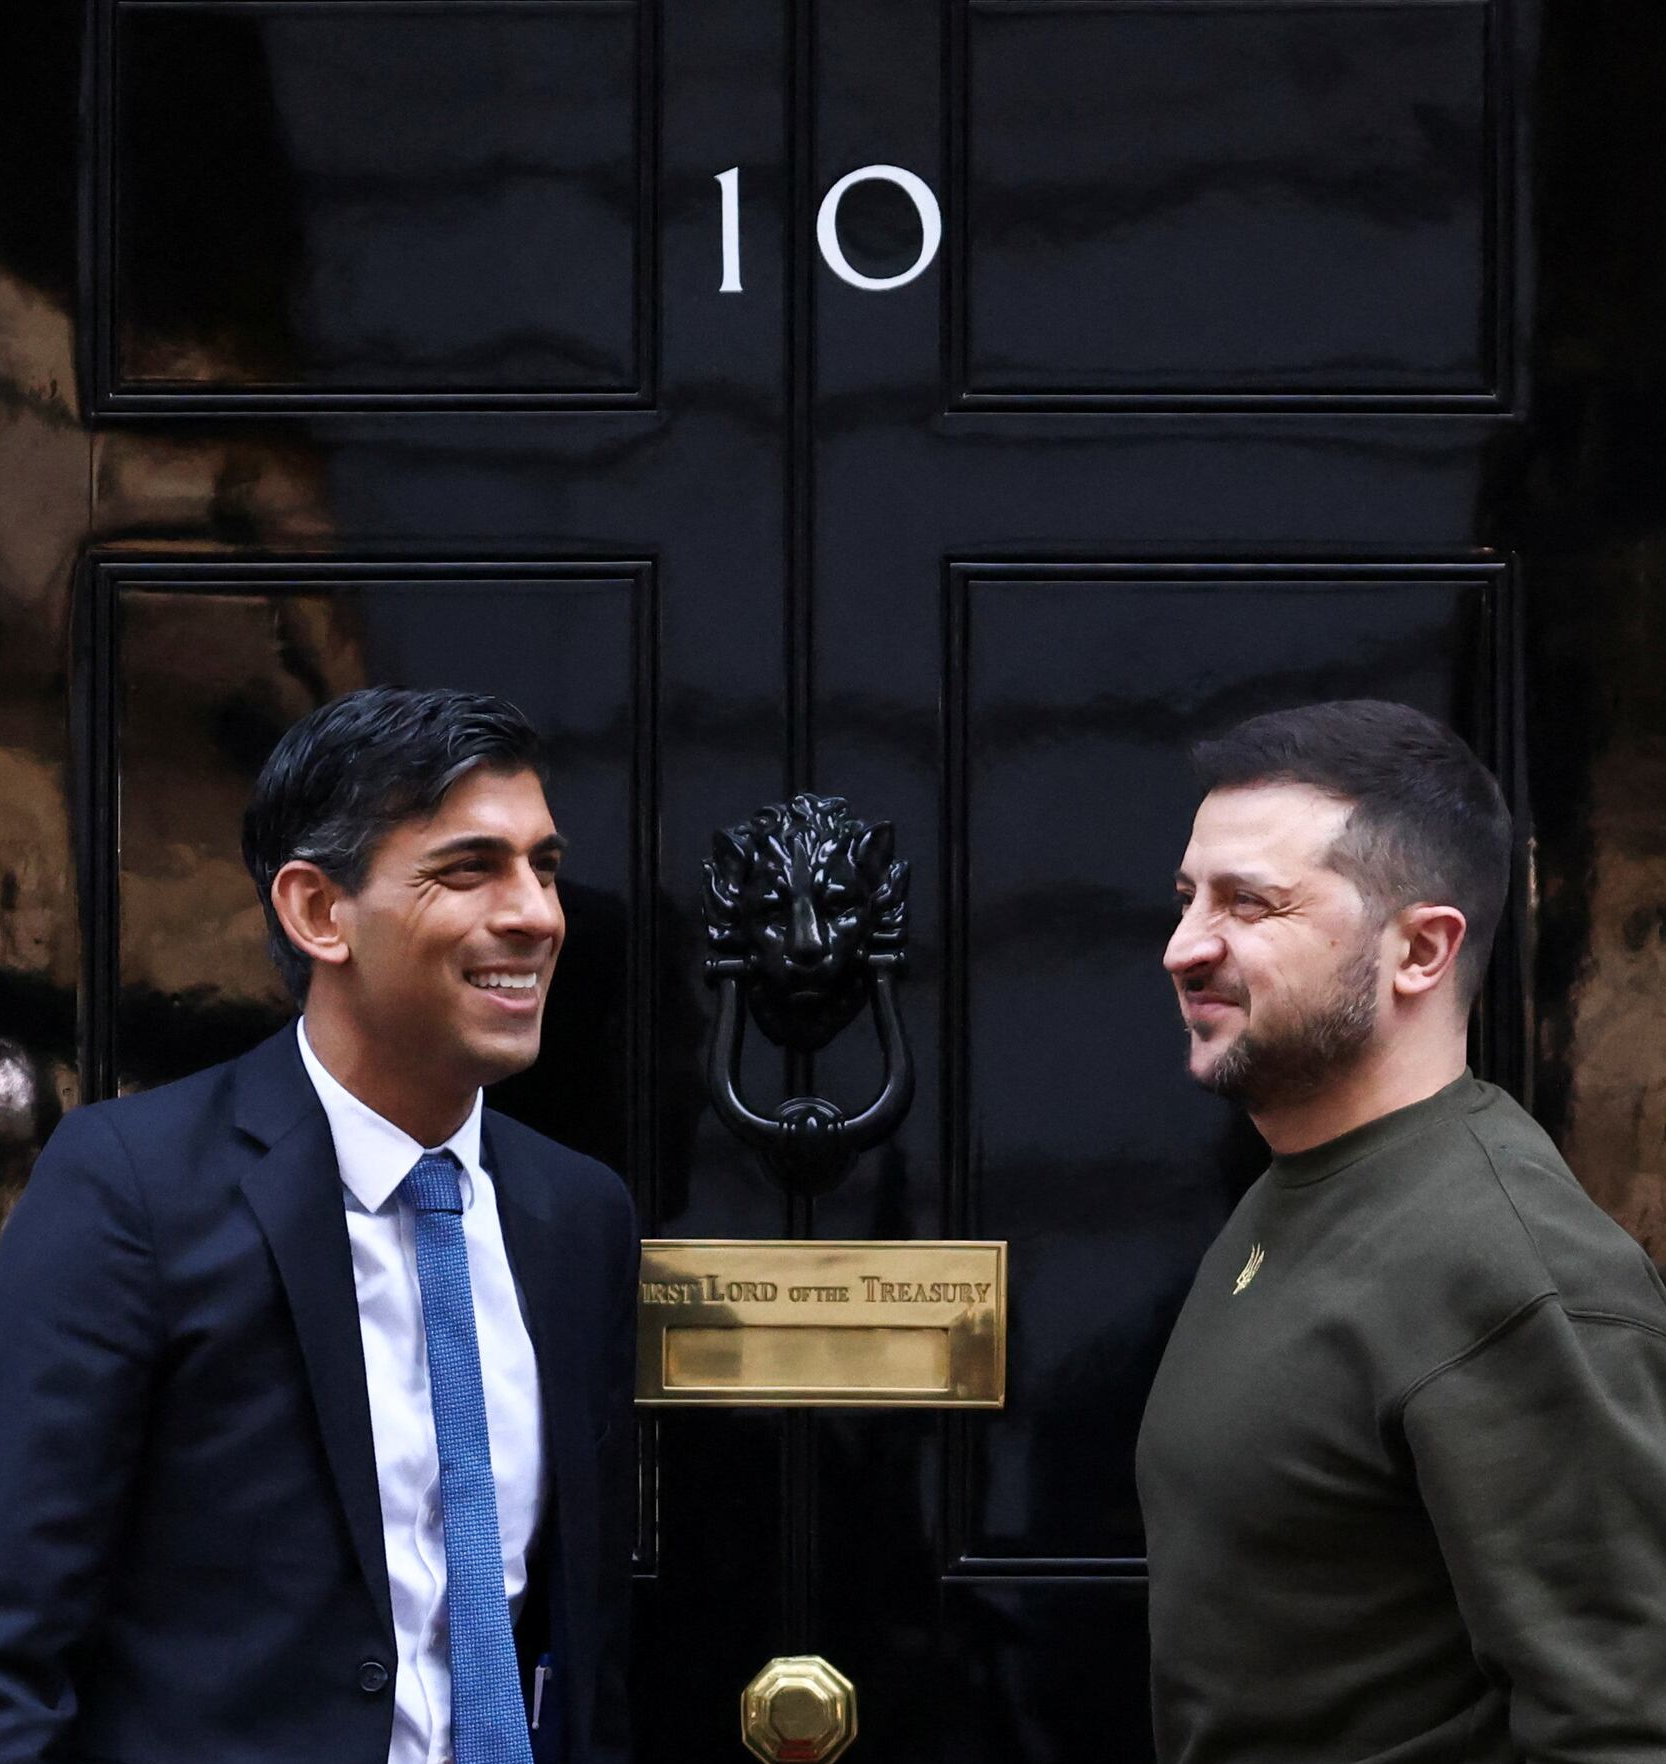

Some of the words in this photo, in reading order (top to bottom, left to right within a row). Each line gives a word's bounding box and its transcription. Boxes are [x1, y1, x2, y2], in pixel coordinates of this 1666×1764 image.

[713, 164, 942, 292] 10
[638, 1281, 699, 1304] IRST
[701, 1273, 779, 1303] LORD
[788, 1286, 814, 1303] OF
[815, 1286, 850, 1303] THE
[860, 1275, 992, 1304] TREASURY
